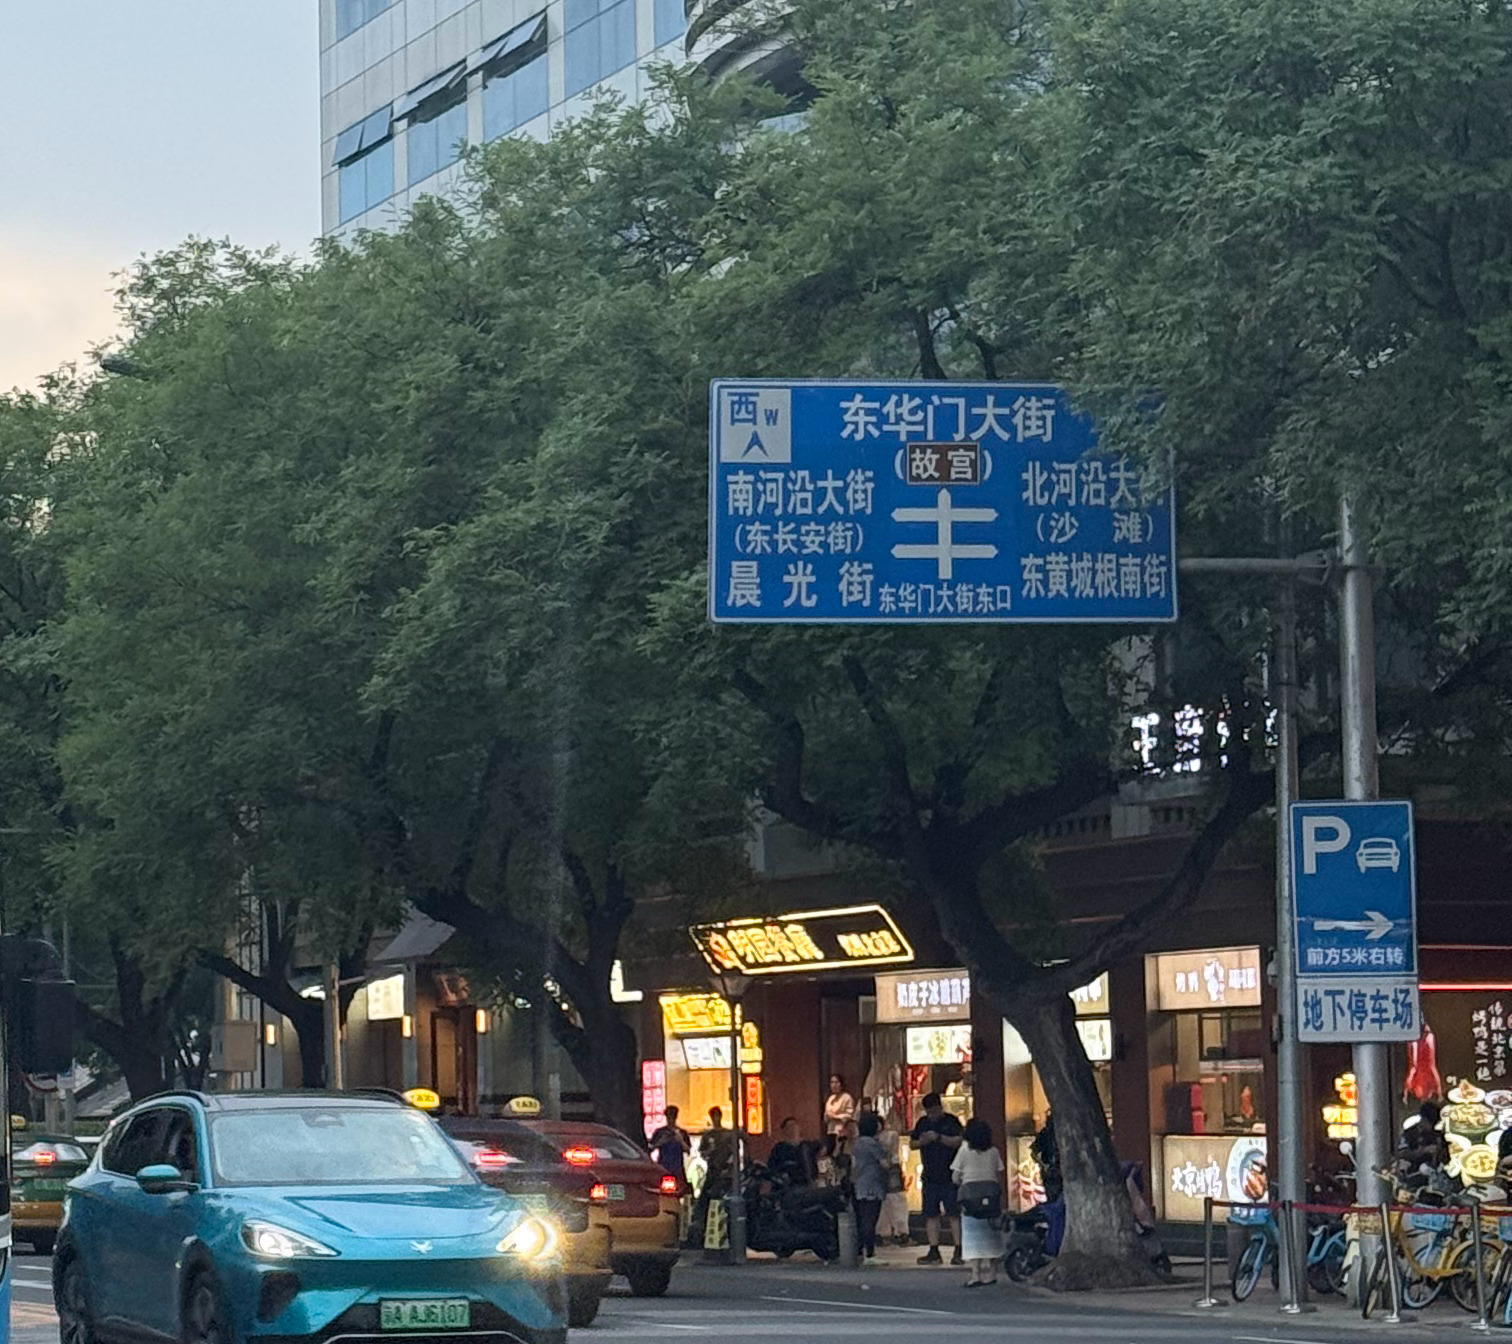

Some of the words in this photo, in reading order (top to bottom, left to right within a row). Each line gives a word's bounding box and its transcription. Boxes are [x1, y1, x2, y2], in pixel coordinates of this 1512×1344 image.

[727, 392, 760, 426] 西
[763, 408, 779, 426] W
[839, 393, 1056, 442] 东华门大街
[726, 468, 875, 517] 南河沿大街
[1021, 455, 1167, 508] 北河沿大
[878, 582, 1012, 614] 东华门大街东口
[1020, 552, 1168, 599] 东黄城根南街
[1302, 815, 1351, 875] P
[1305, 947, 1404, 966] 前方5米右转
[1302, 988, 1413, 1032] 地下停车场
